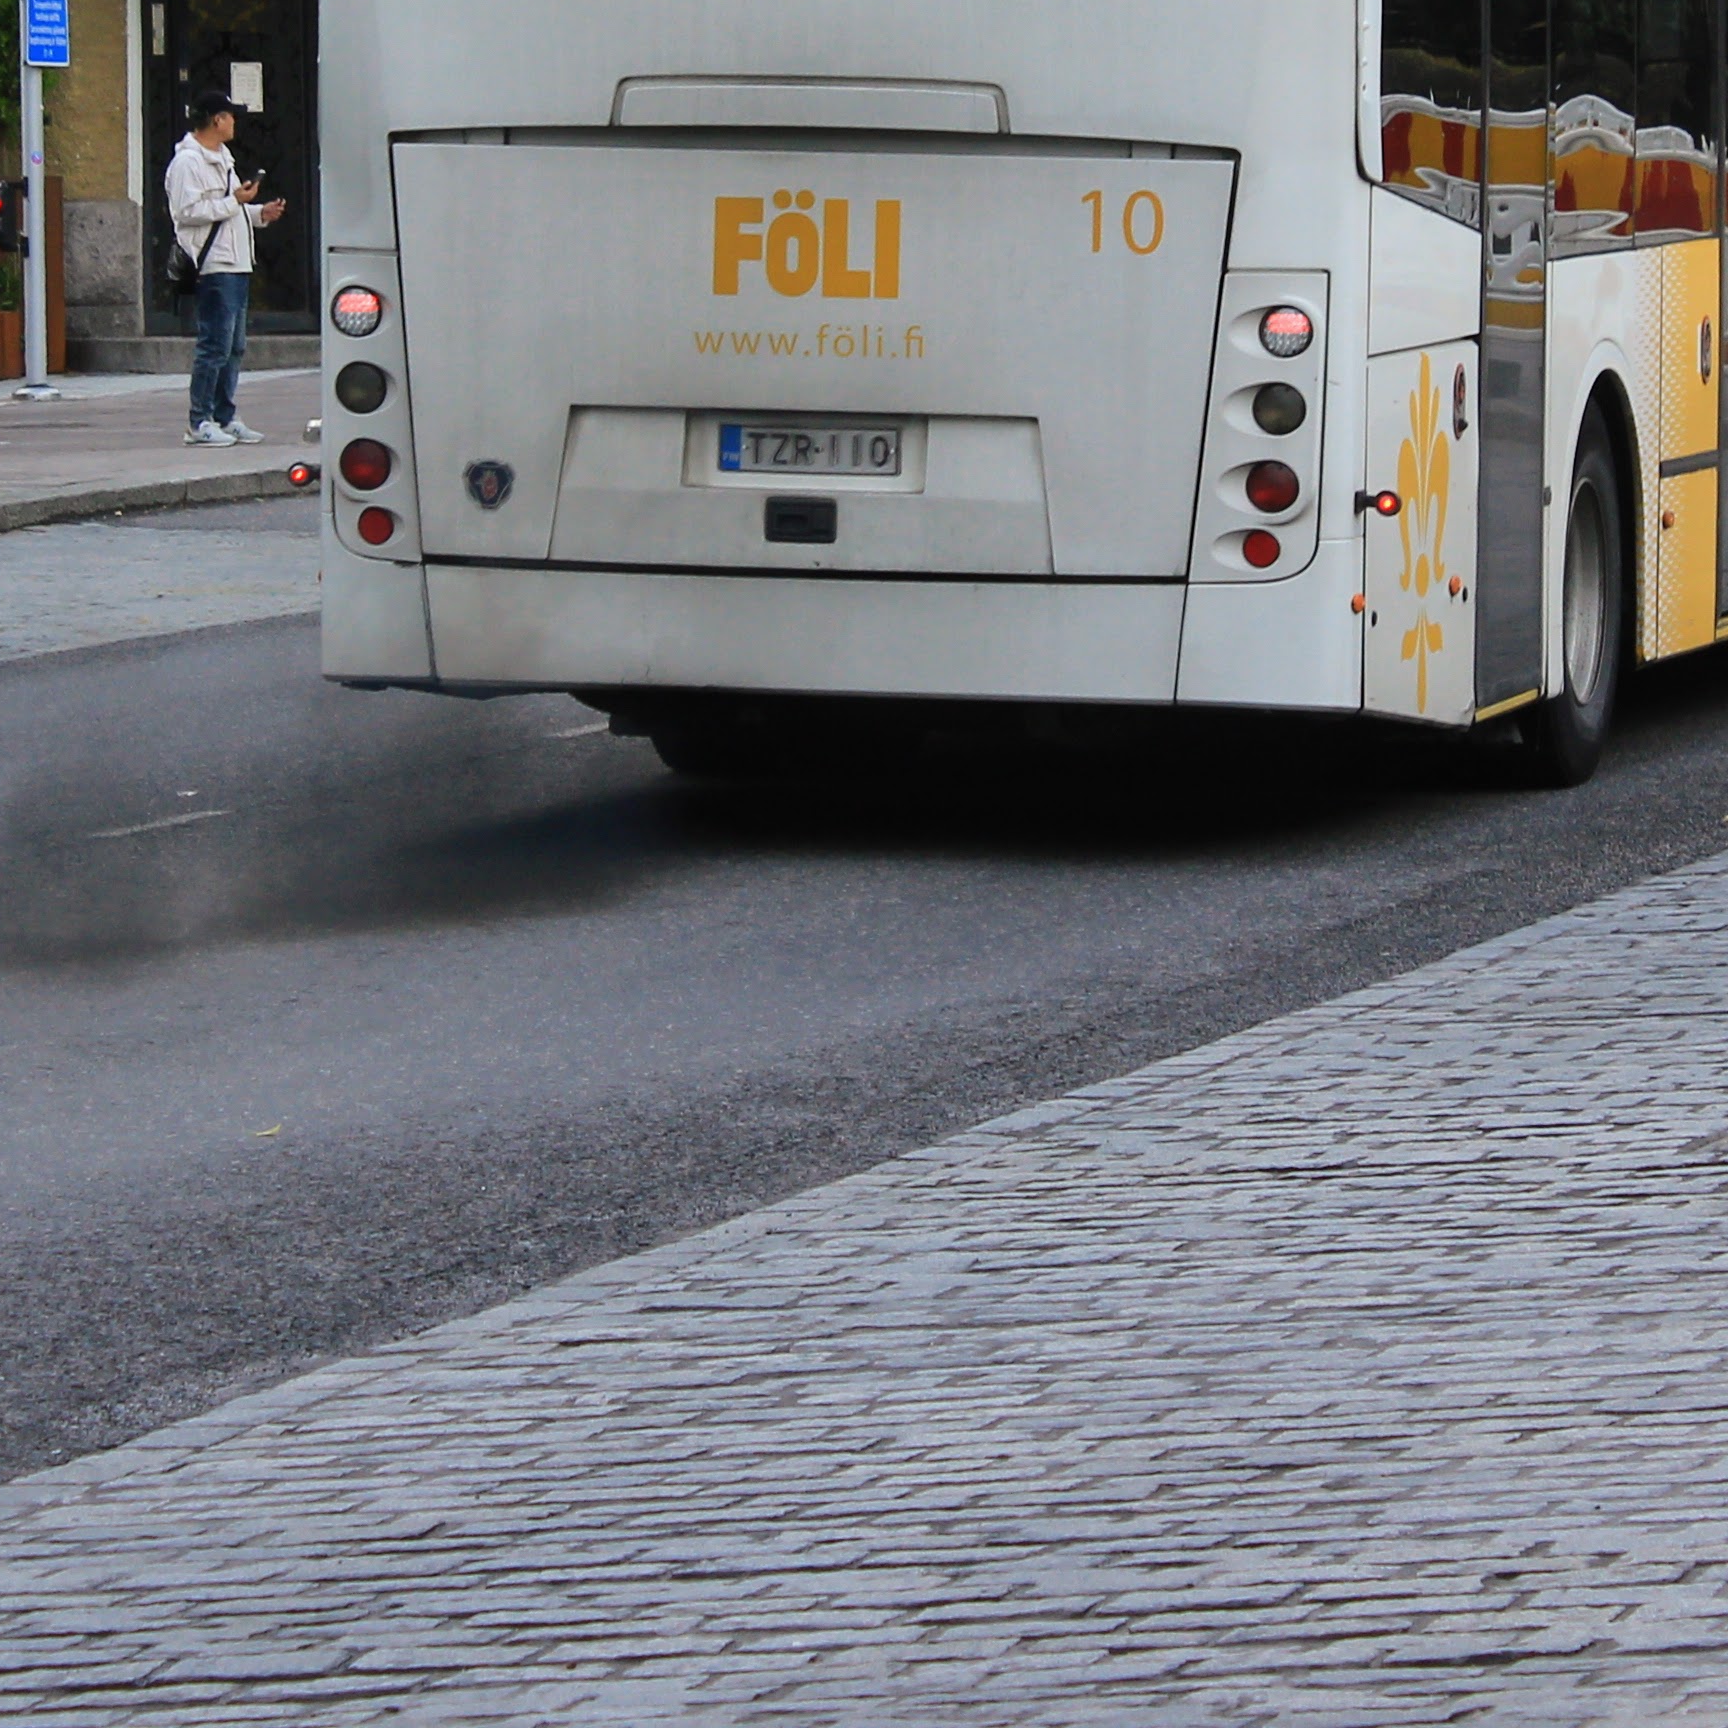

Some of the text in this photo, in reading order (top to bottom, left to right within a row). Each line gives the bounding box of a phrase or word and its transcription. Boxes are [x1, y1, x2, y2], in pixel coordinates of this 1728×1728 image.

[712, 188, 901, 299] FÖLI
[1080, 189, 1165, 256] 10
[694, 324, 926, 359] www.föli.fi
